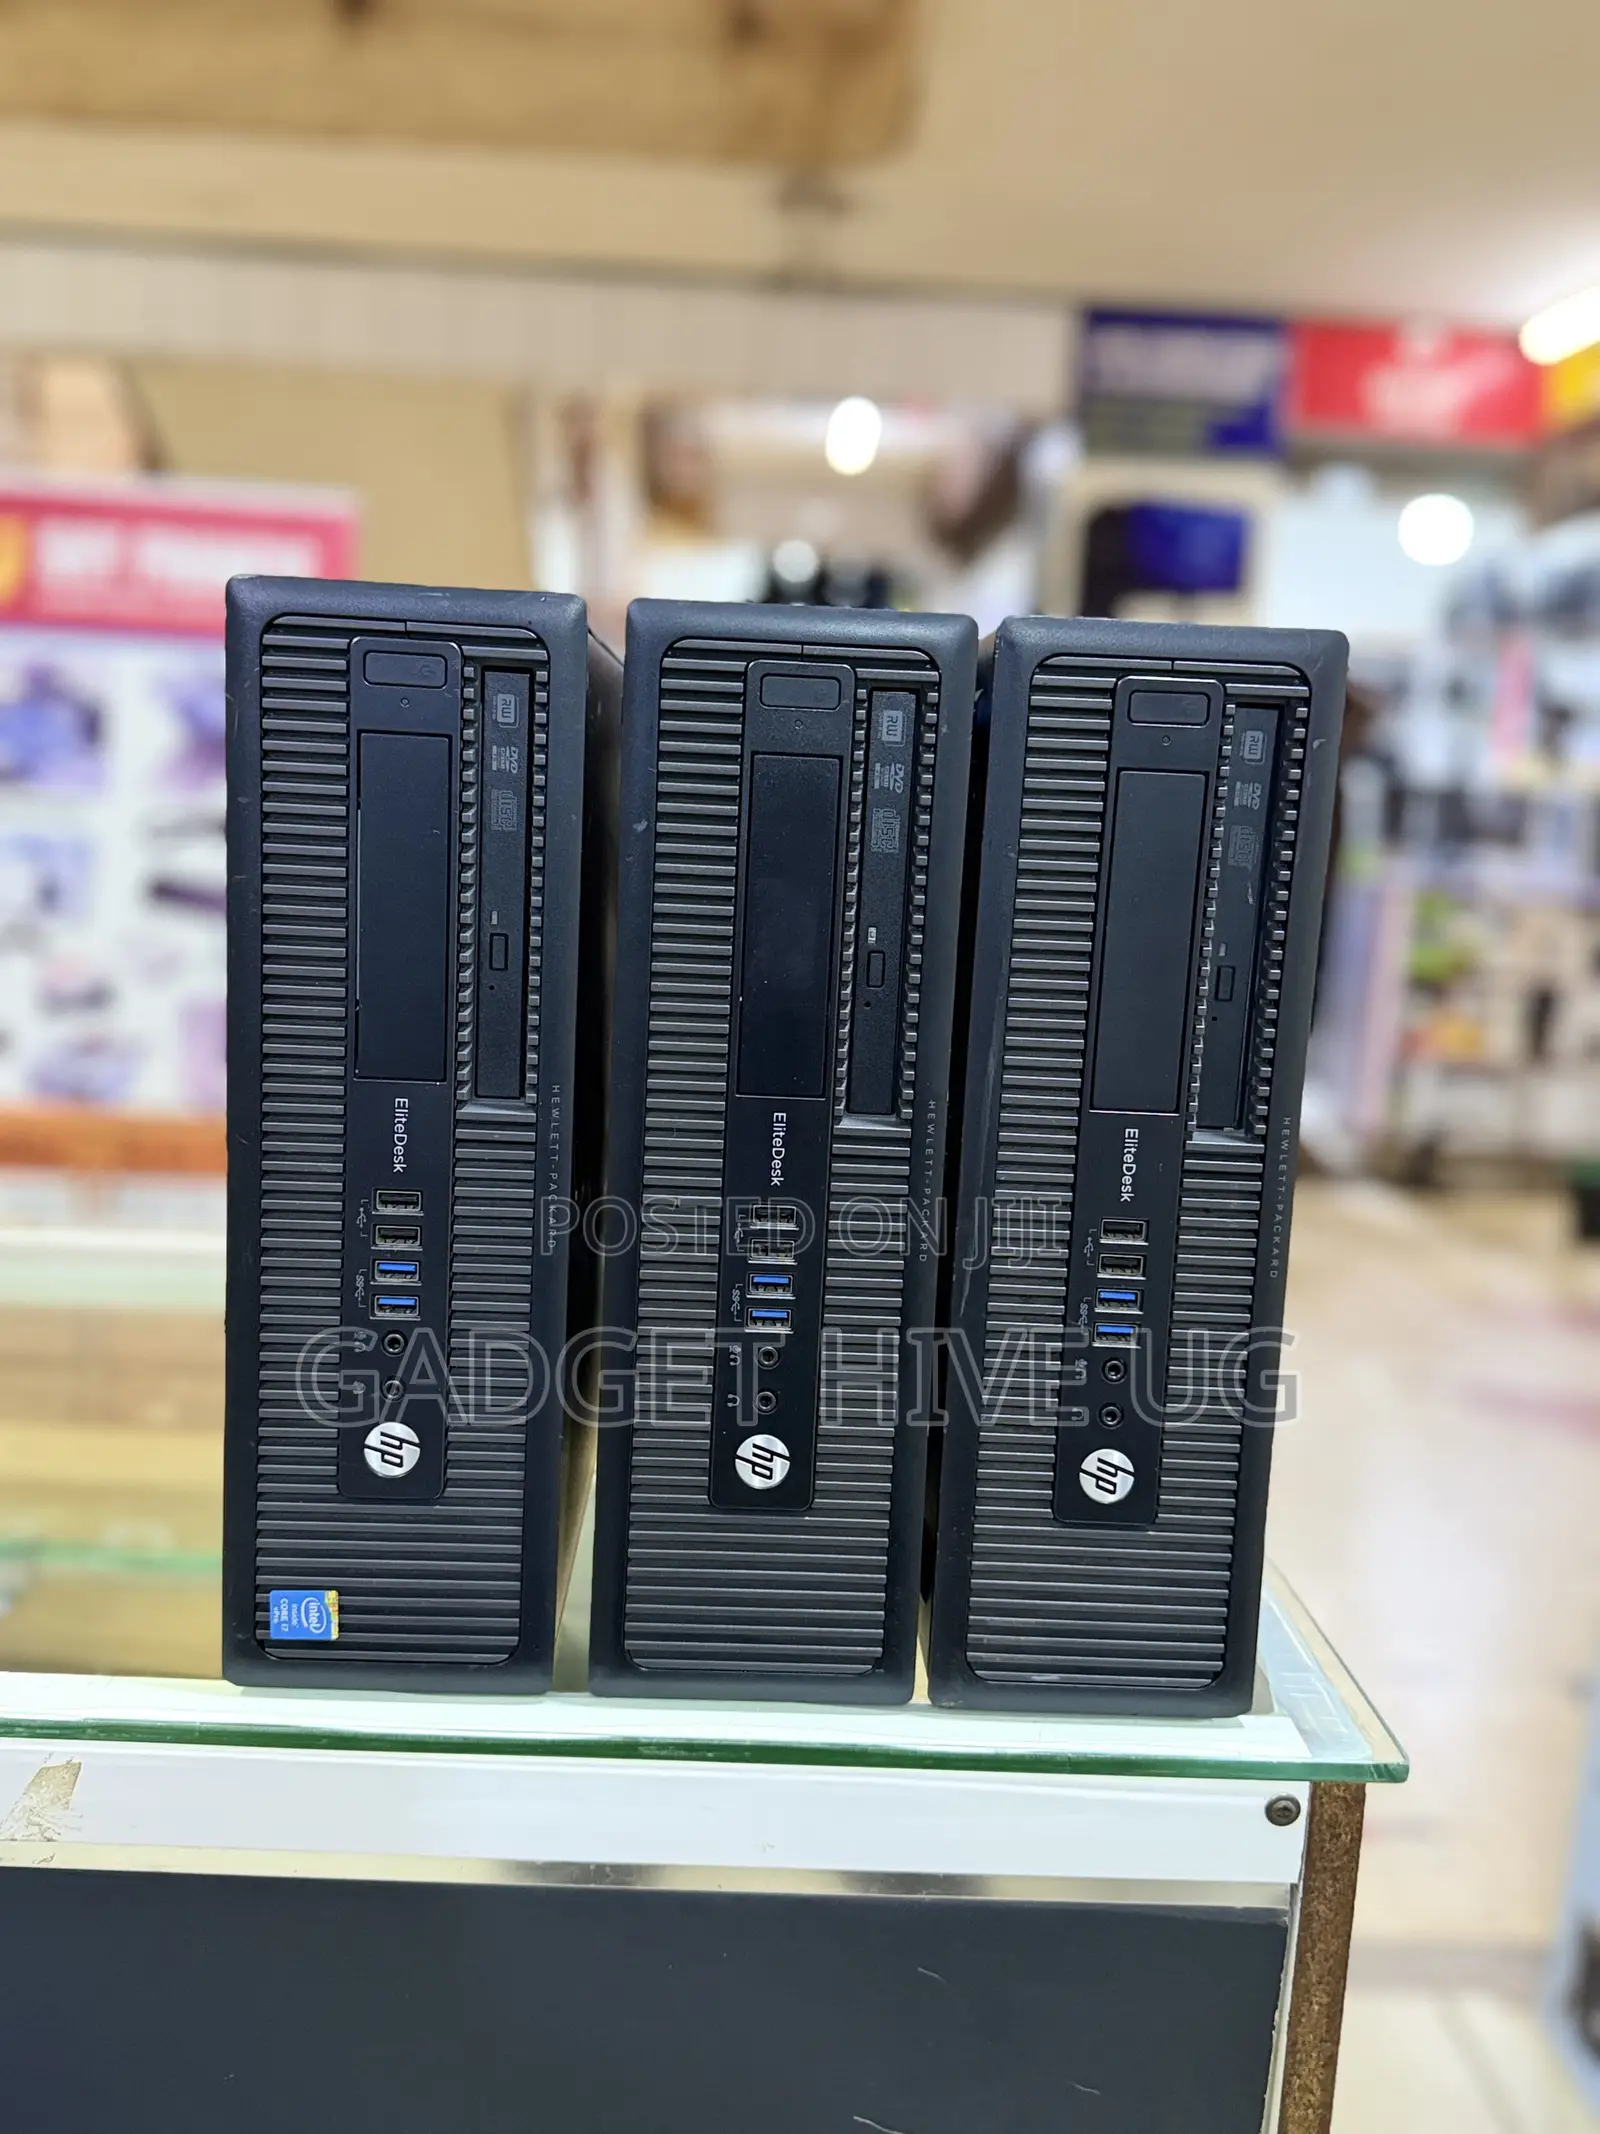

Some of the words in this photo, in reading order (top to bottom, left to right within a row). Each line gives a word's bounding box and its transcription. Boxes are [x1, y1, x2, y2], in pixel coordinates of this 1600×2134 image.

[501, 697, 512, 719] RW
[886, 715, 899, 737] RW
[510, 746, 519, 774] DVD
[1249, 735, 1260, 756] RW
[895, 763, 905, 794] DVD
[1252, 783, 1261, 810] DVD
[393, 1097, 408, 1173] EliteDesk
[770, 1111, 787, 1187] EliteDesk
[1119, 1128, 1139, 1203] EliteDesk
[364, 1430, 420, 1470] hp
[735, 1442, 790, 1482] hp
[1079, 1456, 1135, 1497] hp
[280, 1597, 289, 1621] CORE
